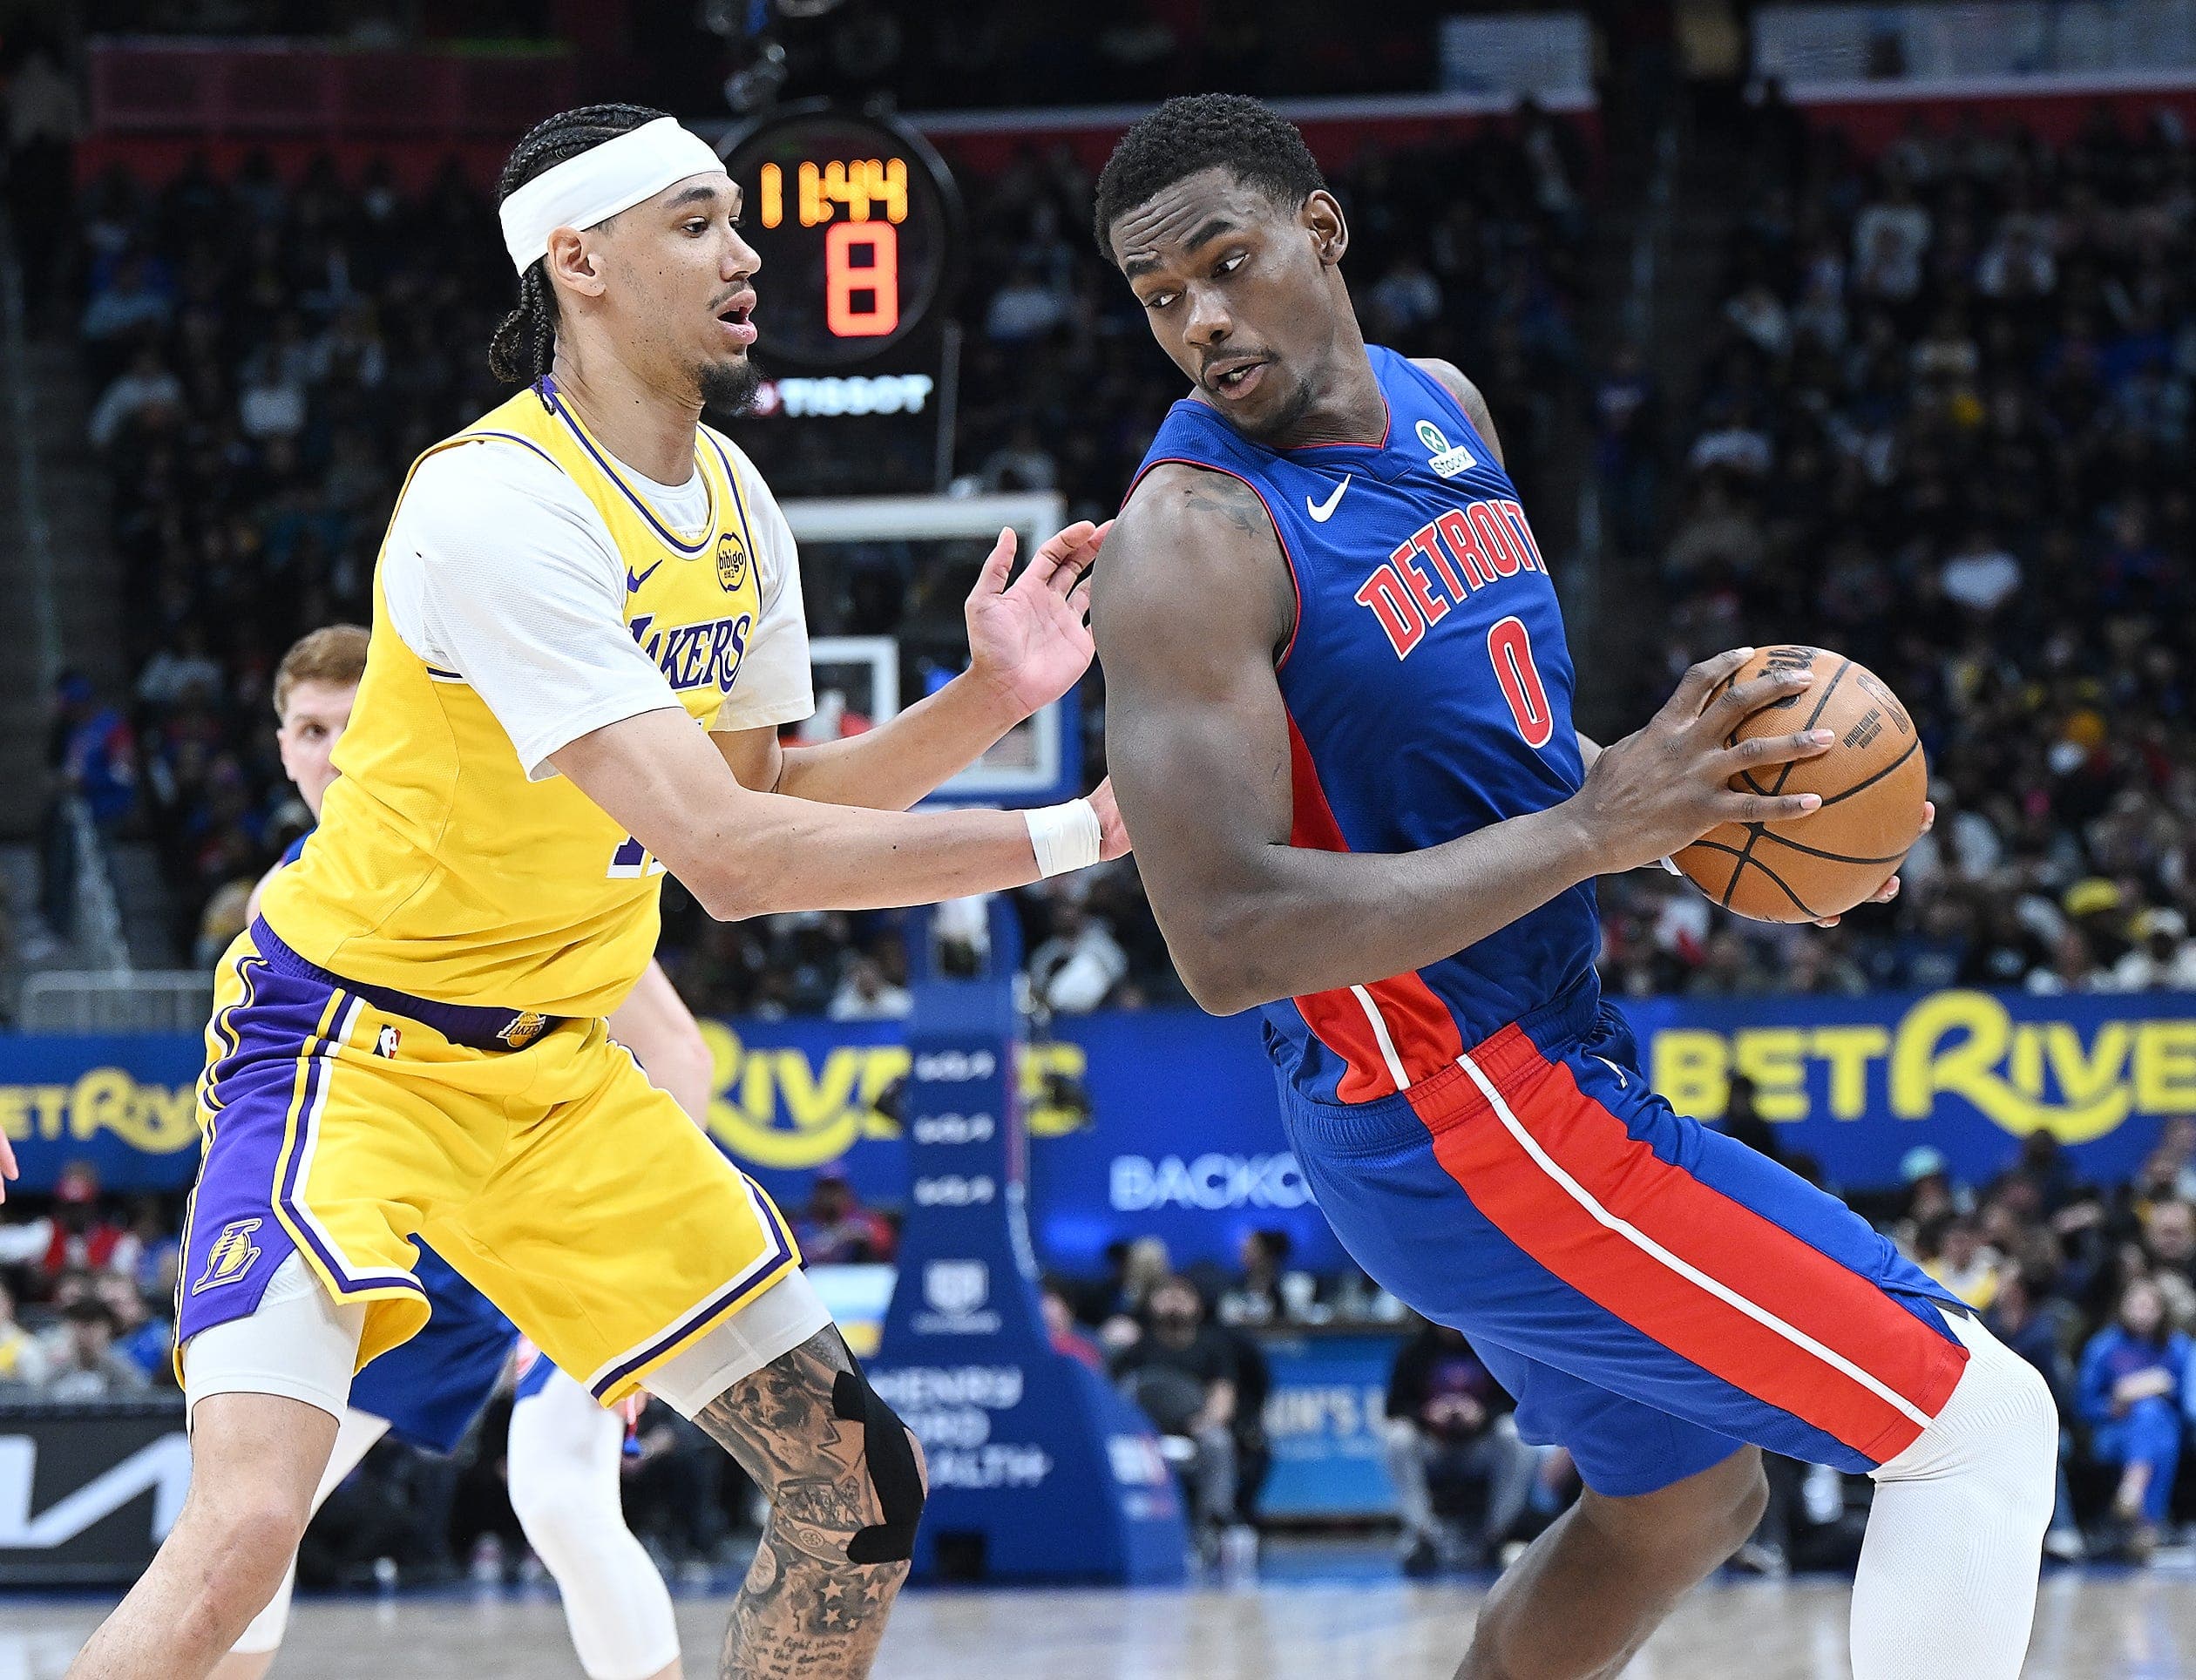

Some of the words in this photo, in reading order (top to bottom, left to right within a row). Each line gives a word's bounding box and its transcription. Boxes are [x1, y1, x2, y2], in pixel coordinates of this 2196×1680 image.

[825, 220, 899, 338] 8
[718, 548, 744, 573] bibigo
[1487, 615, 1554, 749] 0
